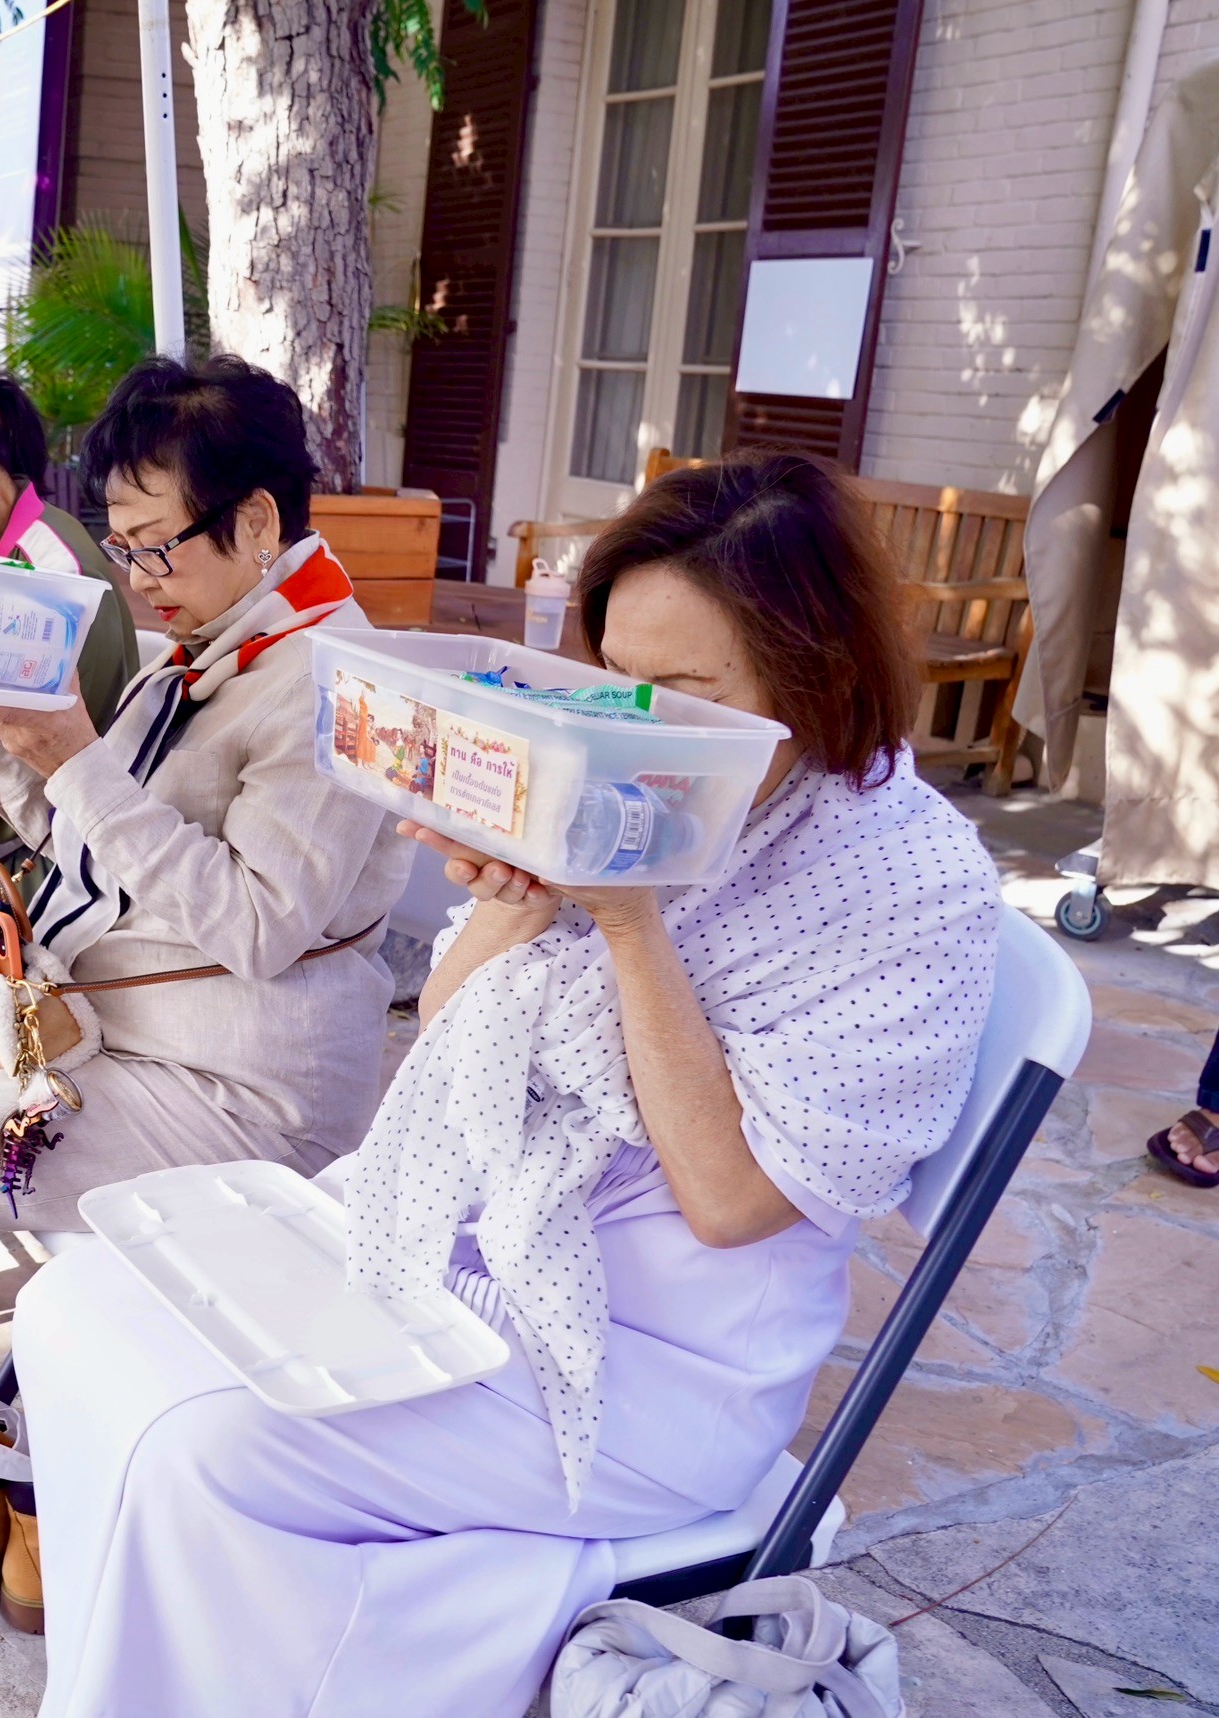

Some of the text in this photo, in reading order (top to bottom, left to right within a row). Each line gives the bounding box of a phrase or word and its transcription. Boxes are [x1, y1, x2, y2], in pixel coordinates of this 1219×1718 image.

[611, 690, 633, 700] SOUP
[450, 746, 516, 779] ทาน คือ การให้
